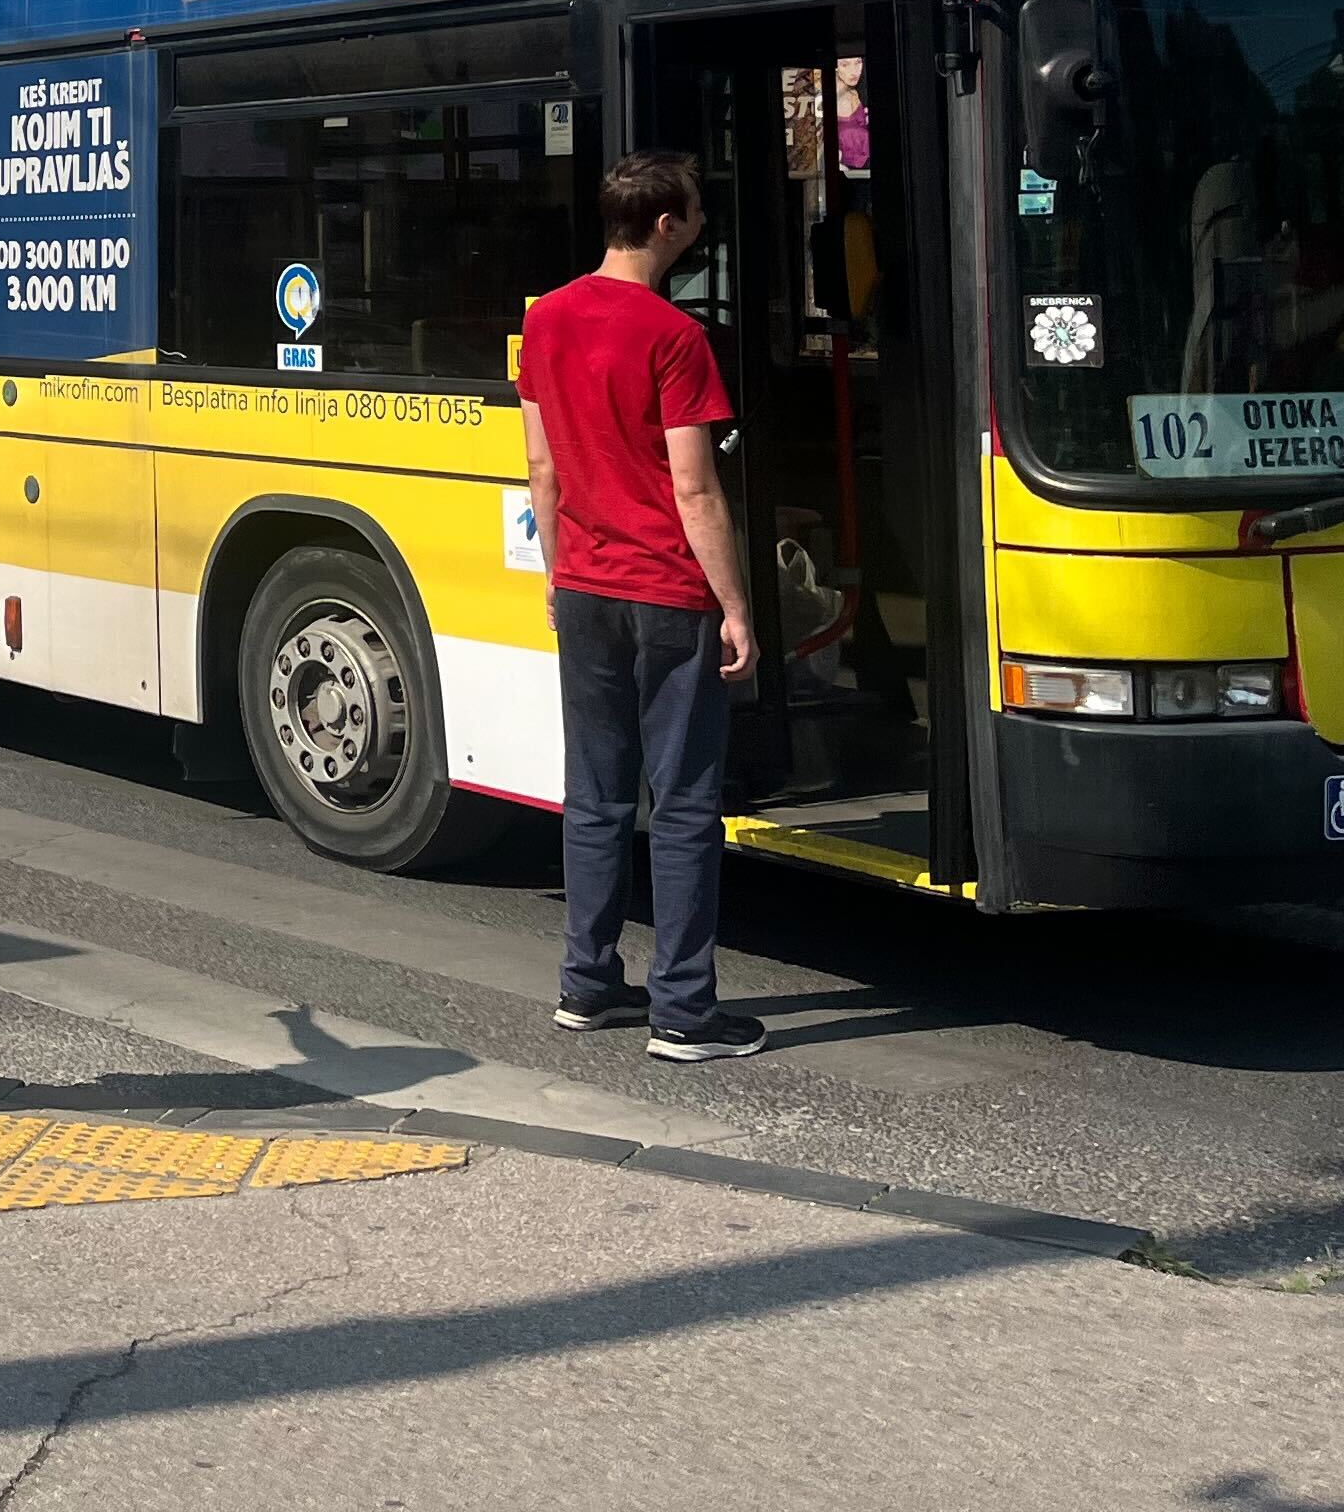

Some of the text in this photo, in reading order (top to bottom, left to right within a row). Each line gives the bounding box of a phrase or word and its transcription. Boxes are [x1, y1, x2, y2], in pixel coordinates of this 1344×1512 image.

[19, 78, 103, 109] KEŠ KREDIT
[11, 106, 112, 152] KOJIM TI
[25, 240, 62, 270] 300
[67, 239, 96, 269] KM
[100, 237, 130, 269] DO
[7, 274, 116, 312] 3.000 KM
[1030, 297, 1094, 306] SREBRENICA
[283, 347, 316, 368] GRAS
[39, 376, 483, 426] mikrofin.com Besplatna info linija 080 051 055
[1137, 397, 1338, 461] 102 OTOKA
[1244, 436, 1344, 469] JEZERO
